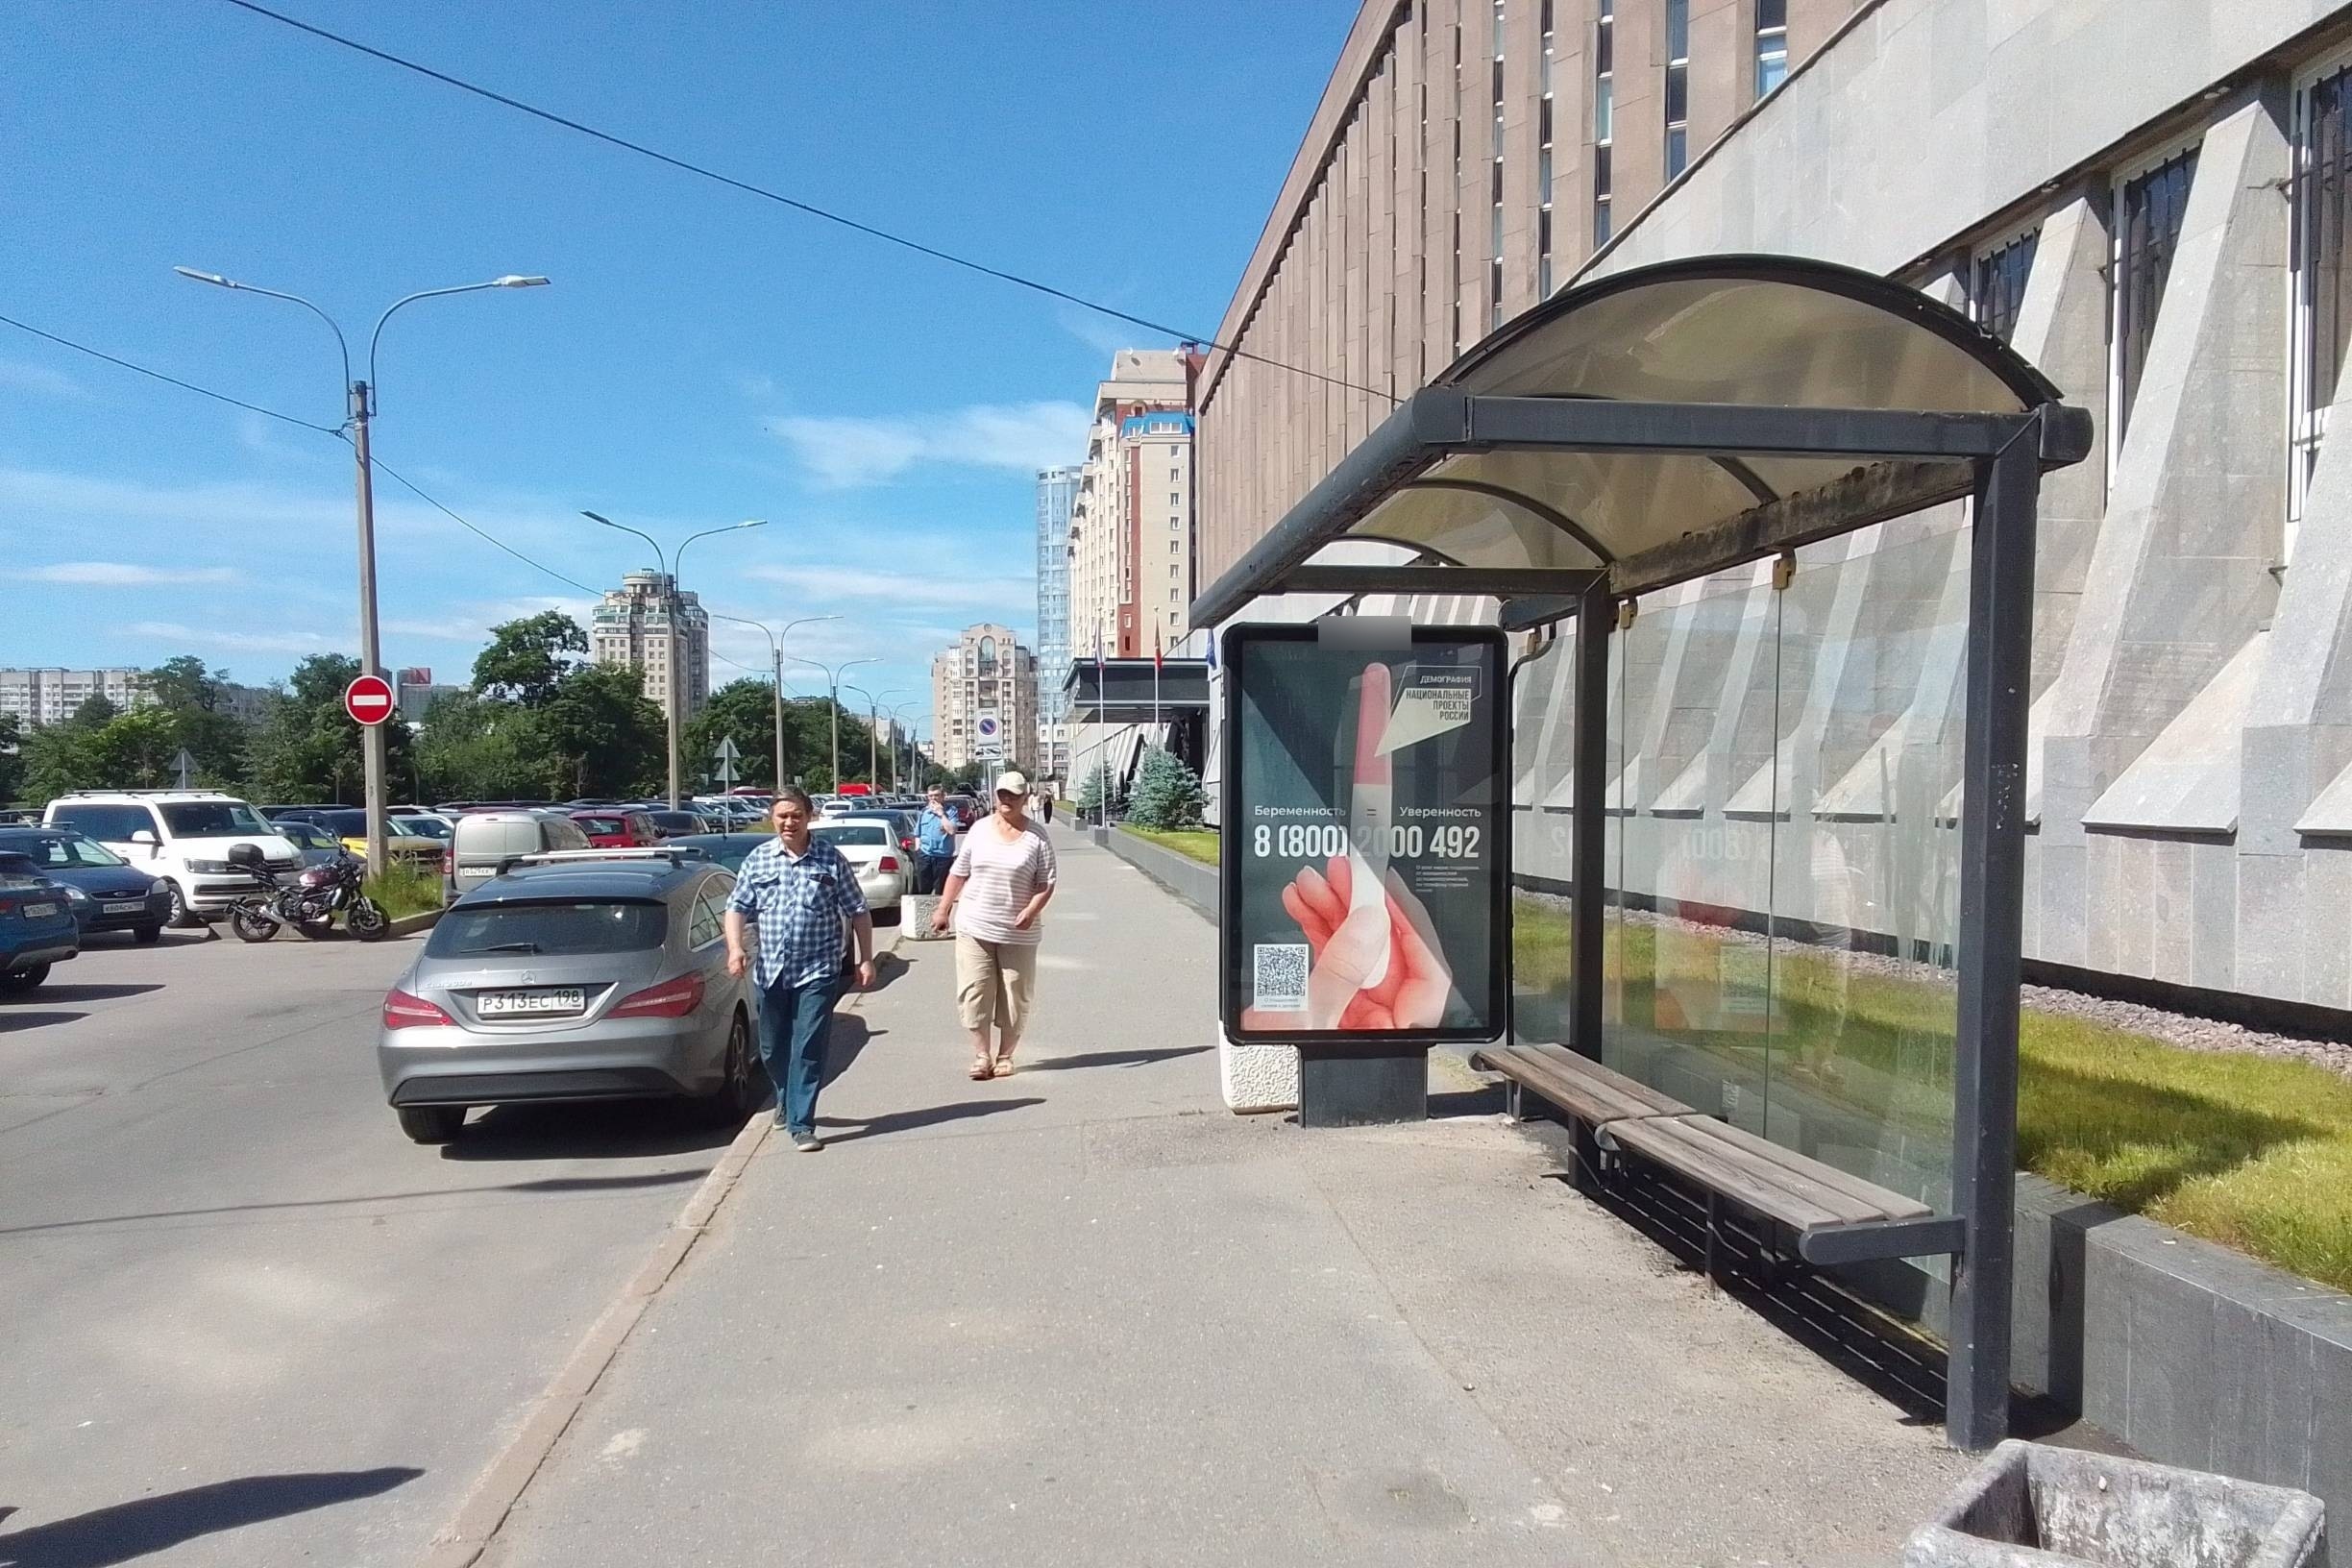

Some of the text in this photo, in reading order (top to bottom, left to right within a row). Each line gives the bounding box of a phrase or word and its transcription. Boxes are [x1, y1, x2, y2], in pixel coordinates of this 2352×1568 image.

[1420, 675, 1472, 685] ДЕМОГРАФИЯ
[1406, 689, 1469, 700] НАЦИОНАЛЬНЫЕ
[1433, 700, 1469, 711] ПРОЕКТЫ
[1439, 711, 1469, 721] РОССИИ
[1254, 805, 1346, 817] Беременность
[1399, 806, 1482, 818] Уверенность
[1254, 824, 1481, 858] 8 (800) 2000 492
